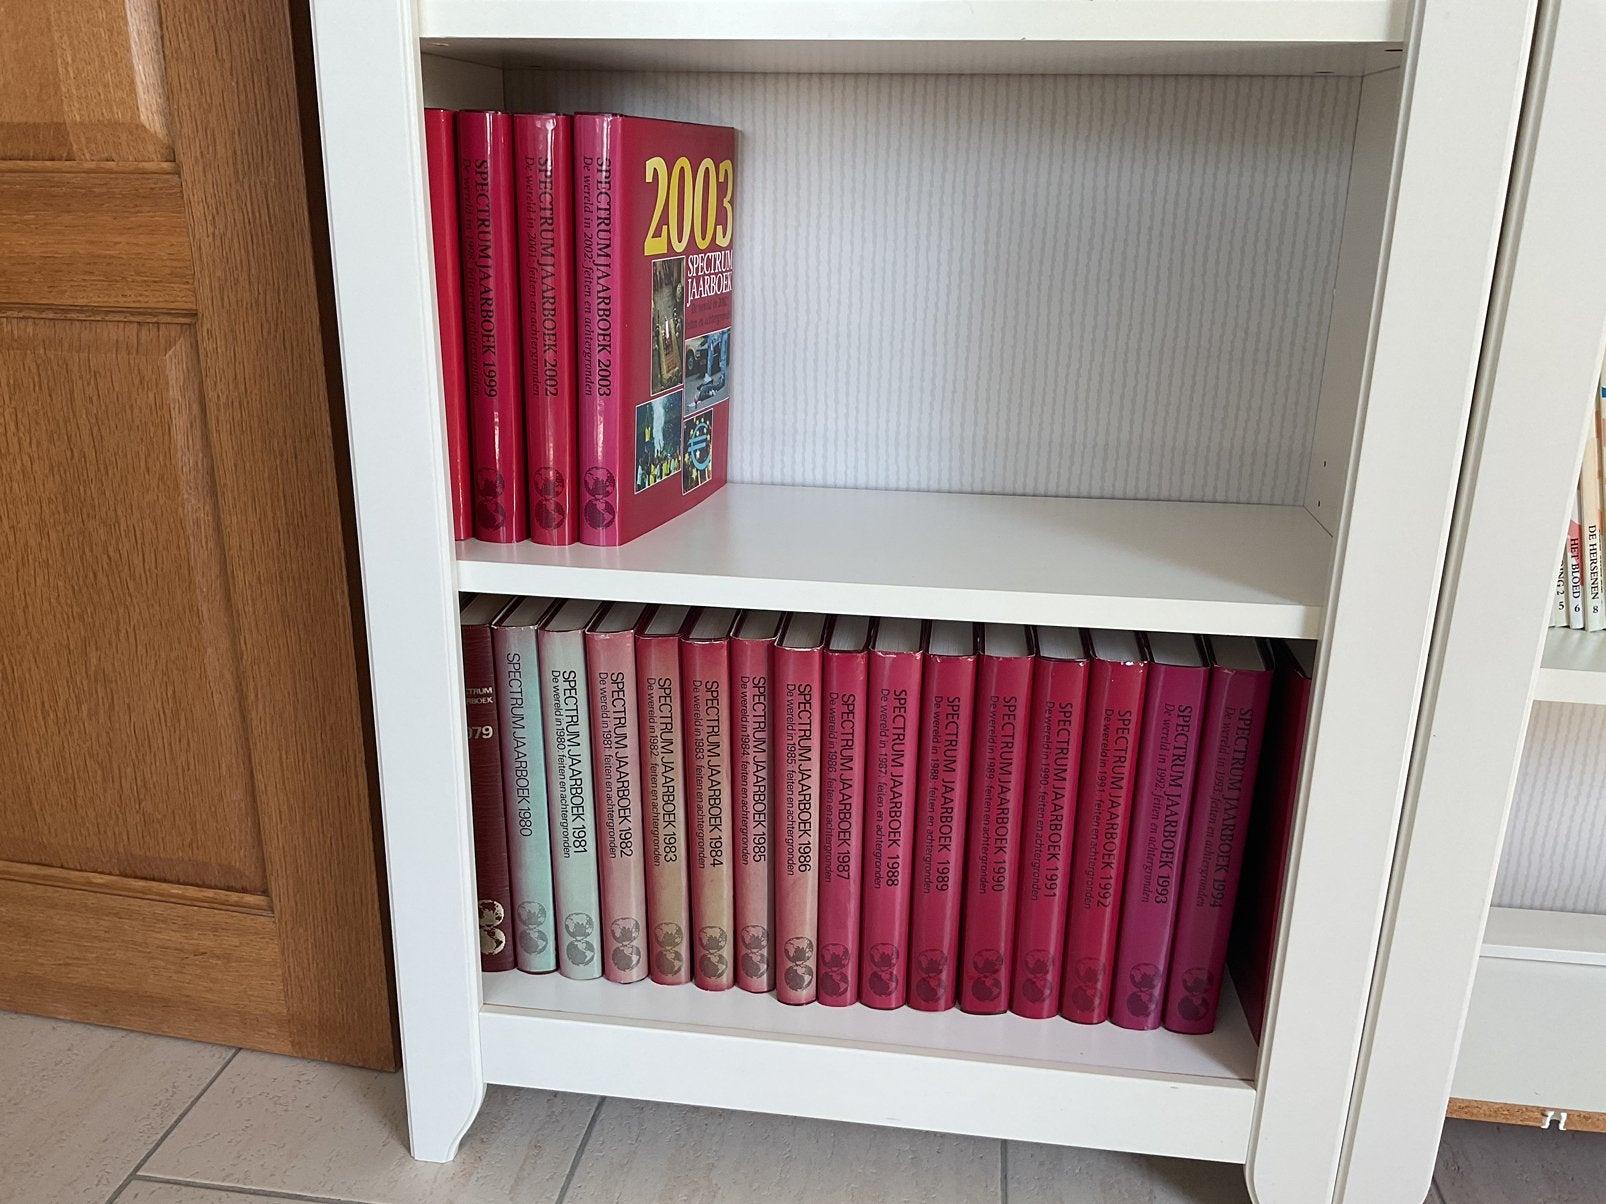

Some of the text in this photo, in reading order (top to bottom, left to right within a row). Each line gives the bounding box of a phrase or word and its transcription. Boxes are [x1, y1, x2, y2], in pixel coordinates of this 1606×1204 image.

[524, 157, 534, 170] De
[583, 156, 593, 170] De
[525, 175, 536, 213] wereld
[583, 175, 593, 213] wereld
[644, 156, 734, 256] 2003
[526, 217, 536, 228] in
[584, 217, 593, 228] in
[474, 159, 497, 397] SPECTRUM JAARBOEK 1999
[538, 155, 558, 396] SPECTRUM JAARBOEK 2002
[594, 156, 611, 396] SPECTRUM JAARBOEK 2003
[688, 249, 733, 277] SPECTRUM
[526, 263, 538, 297] feiten
[582, 264, 593, 296] feiten
[686, 272, 732, 307] JAARBOEK
[583, 300, 591, 313] en
[528, 317, 542, 396] achtergronden
[582, 317, 593, 395] achtergronden
[1589, 525, 1599, 600] DE HERSENEN
[1572, 564, 1580, 598] BLOED
[1558, 602, 1564, 610] 5
[551, 670, 560, 683] De
[598, 672, 608, 685] De
[646, 677, 656, 690] De
[692, 680, 702, 692] De
[740, 676, 750, 689] De
[786, 683, 796, 696] De
[552, 685, 563, 716] wereld
[599, 687, 610, 718] wereld
[647, 692, 657, 724] wereld
[740, 691, 750, 722] wereld
[828, 691, 838, 705] De
[880, 688, 890, 701] De
[934, 695, 943, 708] De
[1164, 703, 1175, 716] De
[555, 718, 564, 726] in
[601, 720, 611, 728] in
[693, 695, 703, 726] wereld
[786, 698, 796, 730] wereld
[827, 707, 838, 739] wereld
[879, 704, 889, 737] wereld
[648, 725, 658, 733] in
[693, 728, 703, 736] in
[740, 724, 747, 732] in
[786, 732, 796, 740] in
[932, 711, 942, 743] wereld
[1160, 719, 1172, 751] wereld
[506, 653, 532, 836] SPECTRUM JAARBOEK 1980
[827, 740, 837, 749] in
[878, 740, 888, 748] in
[931, 746, 940, 754] in
[1158, 754, 1168, 763] in
[557, 754, 566, 779] feiten
[562, 670, 587, 852] SPECTRUM JAARBOEK 1981
[604, 754, 613, 782] feiten
[610, 672, 633, 858] SPECTRUM JAARBOEK 1982
[649, 762, 659, 788] feiten
[657, 678, 677, 862] SPECTRUM JAARBOEK 1983
[705, 680, 723, 867] SPECTRUM JAARBOEK 1984
[740, 760, 750, 786] feiten
[752, 676, 766, 862] SPECTRUM JAARBOEK 1985
[559, 782, 566, 792] en
[604, 783, 612, 794] en
[696, 764, 705, 790] feiten
[740, 787, 748, 798] en
[786, 770, 796, 794] feiten
[797, 684, 812, 872] SPECTRUM JAARBOEK 1986
[825, 777, 836, 803] feiten
[836, 694, 855, 879] SPECTRUM JAARBOEK 1987
[886, 689, 907, 886] SPECTRUM JAARBOEK 1988
[650, 789, 658, 800] en
[696, 791, 703, 802] en
[786, 796, 793, 807] en
[877, 782, 886, 807] feiten
[927, 787, 938, 813] feiten
[936, 696, 960, 891] SPECTRUM JAARBOEK 1989
[991, 696, 1017, 891] SPECTRUM JAARBOEK 1990
[1044, 702, 1072, 897] SPECTRUM JAARBOEK 1991
[1096, 710, 1132, 908] SPECTRUM JAARBOEK 1992
[1151, 791, 1164, 820] feiten
[1154, 704, 1192, 903] SPECTRUM JAARBOEK 1993
[1209, 708, 1254, 907] SPECTRUM JAARBOEK 1994
[560, 793, 572, 858] achtergronden
[606, 794, 618, 858] achtergronden
[876, 810, 883, 821] en
[926, 815, 934, 826] en
[1149, 823, 1158, 833] en
[650, 801, 662, 866] achtergronden
[695, 804, 707, 868] achtergronden
[739, 799, 750, 865] achtergronden
[784, 807, 796, 875] achtergronden
[823, 814, 835, 882] achtergronden
[872, 824, 885, 888] achtergronden
[922, 829, 935, 893] achtergronden
[1141, 836, 1158, 902] achtergronden
